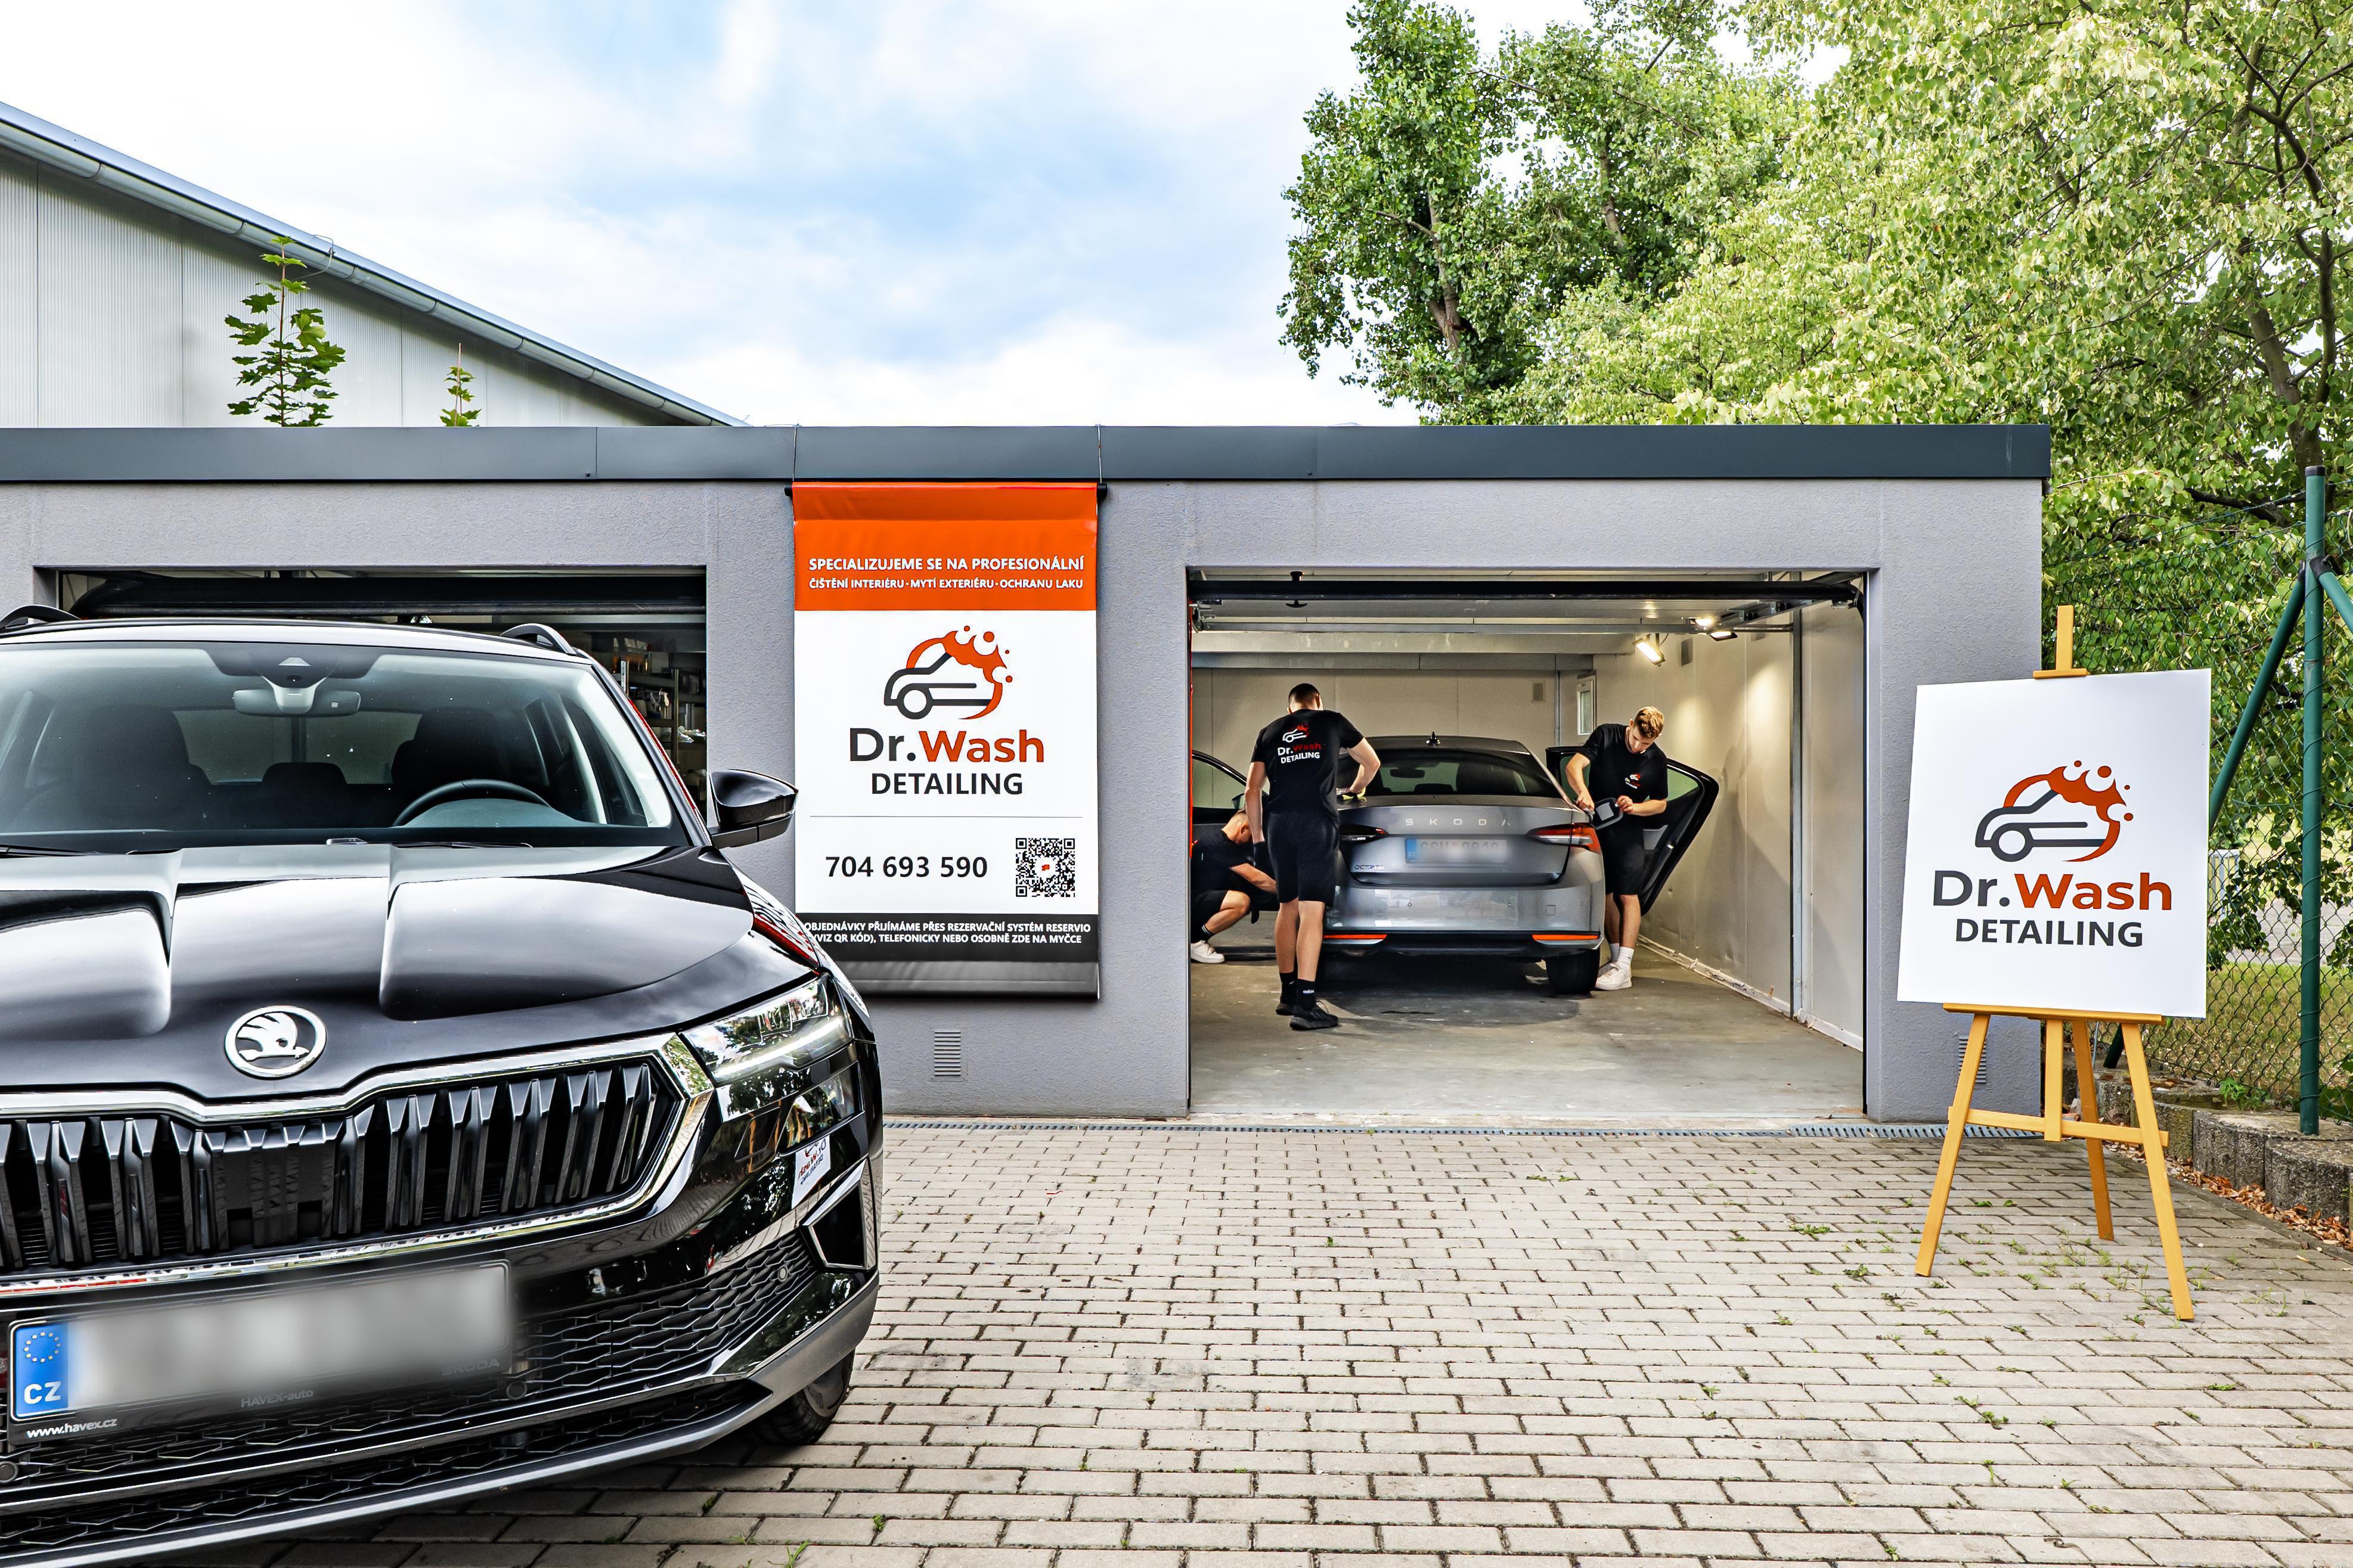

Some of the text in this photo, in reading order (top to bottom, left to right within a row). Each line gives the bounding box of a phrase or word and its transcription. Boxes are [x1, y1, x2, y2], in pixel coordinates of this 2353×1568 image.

[809, 555, 1084, 570] SPECIALIZUJEME SE NA PROFESIONÁLNÍ
[809, 577, 848, 589] ČIŠTĚNÍ
[851, 577, 904, 589] INTERIÉRU
[1000, 579, 1052, 589] OCHRANU
[1056, 579, 1083, 589] LAKU
[1281, 752, 1320, 763] DETAILING
[872, 773, 1022, 794] DETAILING
[826, 856, 988, 877] 704 693 590
[805, 921, 1090, 932] OBJEDNÁVKY PŘIJÍMÁME PŘES REZERVAČNÍ SYSTÉM RESERVIO
[1956, 918, 2143, 947] DETAILING
[834, 934, 848, 943] QR
[851, 932, 876, 943] KÓD),
[879, 934, 940, 943] TELEFONICKY
[943, 934, 968, 943] NEBO
[971, 933, 1009, 943] OSOBNĚ
[1012, 934, 1030, 943] ZDE
[1033, 934, 1047, 943] NA
[1049, 933, 1082, 943] MYČCE
[24, 1381, 61, 1404] CZ
[241, 1390, 314, 1408] HAVEX-auto
[27, 1418, 117, 1438] www.havex.cz
